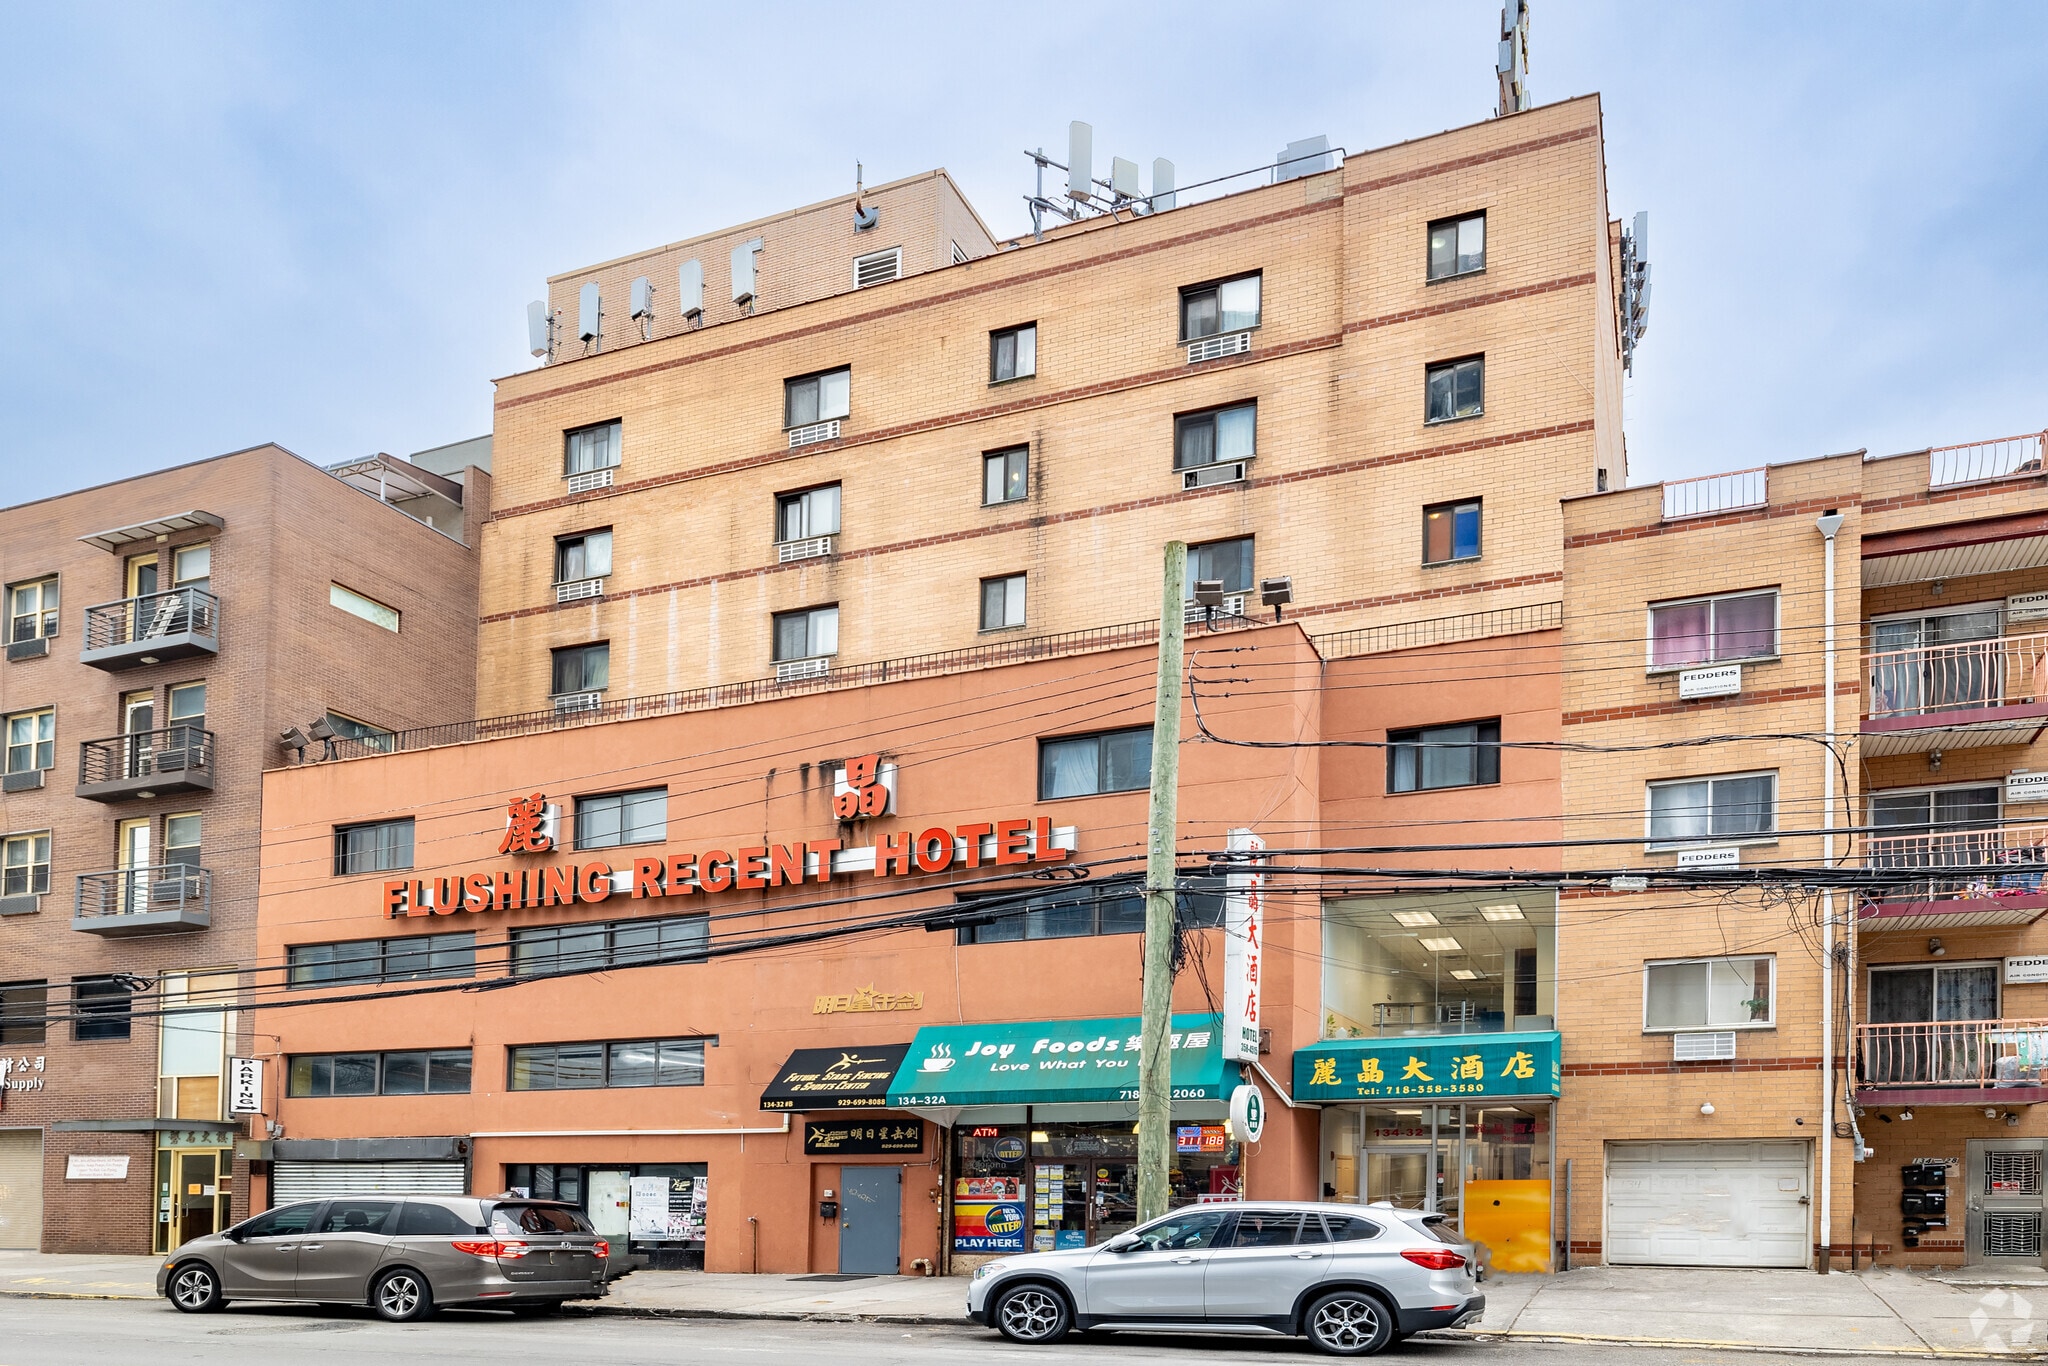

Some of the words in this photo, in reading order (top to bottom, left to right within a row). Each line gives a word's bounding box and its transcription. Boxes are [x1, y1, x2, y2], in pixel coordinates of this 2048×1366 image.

[1683, 669, 1737, 681] FEDDERS
[1696, 683, 1737, 691] CONDITIONER
[497, 792, 552, 854] 麗
[832, 753, 888, 819] 晶
[1681, 852, 1735, 862] FEDDERS
[382, 861, 613, 919] FLUSHING
[631, 838, 844, 898] REGENT
[873, 816, 1068, 877] HOTEL
[964, 1038, 1016, 1059] Joy
[1031, 1036, 1119, 1054] Foods
[989, 1061, 1030, 1072] Love
[1039, 1059, 1088, 1070] What
[1095, 1058, 1129, 1069] You
[1309, 1051, 1536, 1086] 麗晶大酒店
[783, 1073, 821, 1083] FUTURE
[822, 1071, 852, 1081] STARS
[850, 1070, 891, 1081] FENCING
[4, 1076, 45, 1092] Supply
[239, 1060, 254, 1105] PARKING
[800, 1082, 836, 1091] SPORTS
[835, 1081, 871, 1090] CENTER
[1356, 1087, 1380, 1096] Tel:
[1386, 1083, 1484, 1095] 718-358-3580
[837, 1098, 886, 1106] 929-699-8088
[897, 1096, 946, 1105] 134-32A
[973, 1128, 998, 1137] ATM
[1373, 1128, 1424, 1137] 134-32
[1205, 1136, 1224, 1145] 188
[998, 1150, 1023, 1158] LOTTERY
[1004, 1213, 1021, 1221] YORK
[989, 1220, 1022, 1233] LOTTERY
[955, 1239, 985, 1247] PLAY
[987, 1238, 1023, 1247] HERE.
